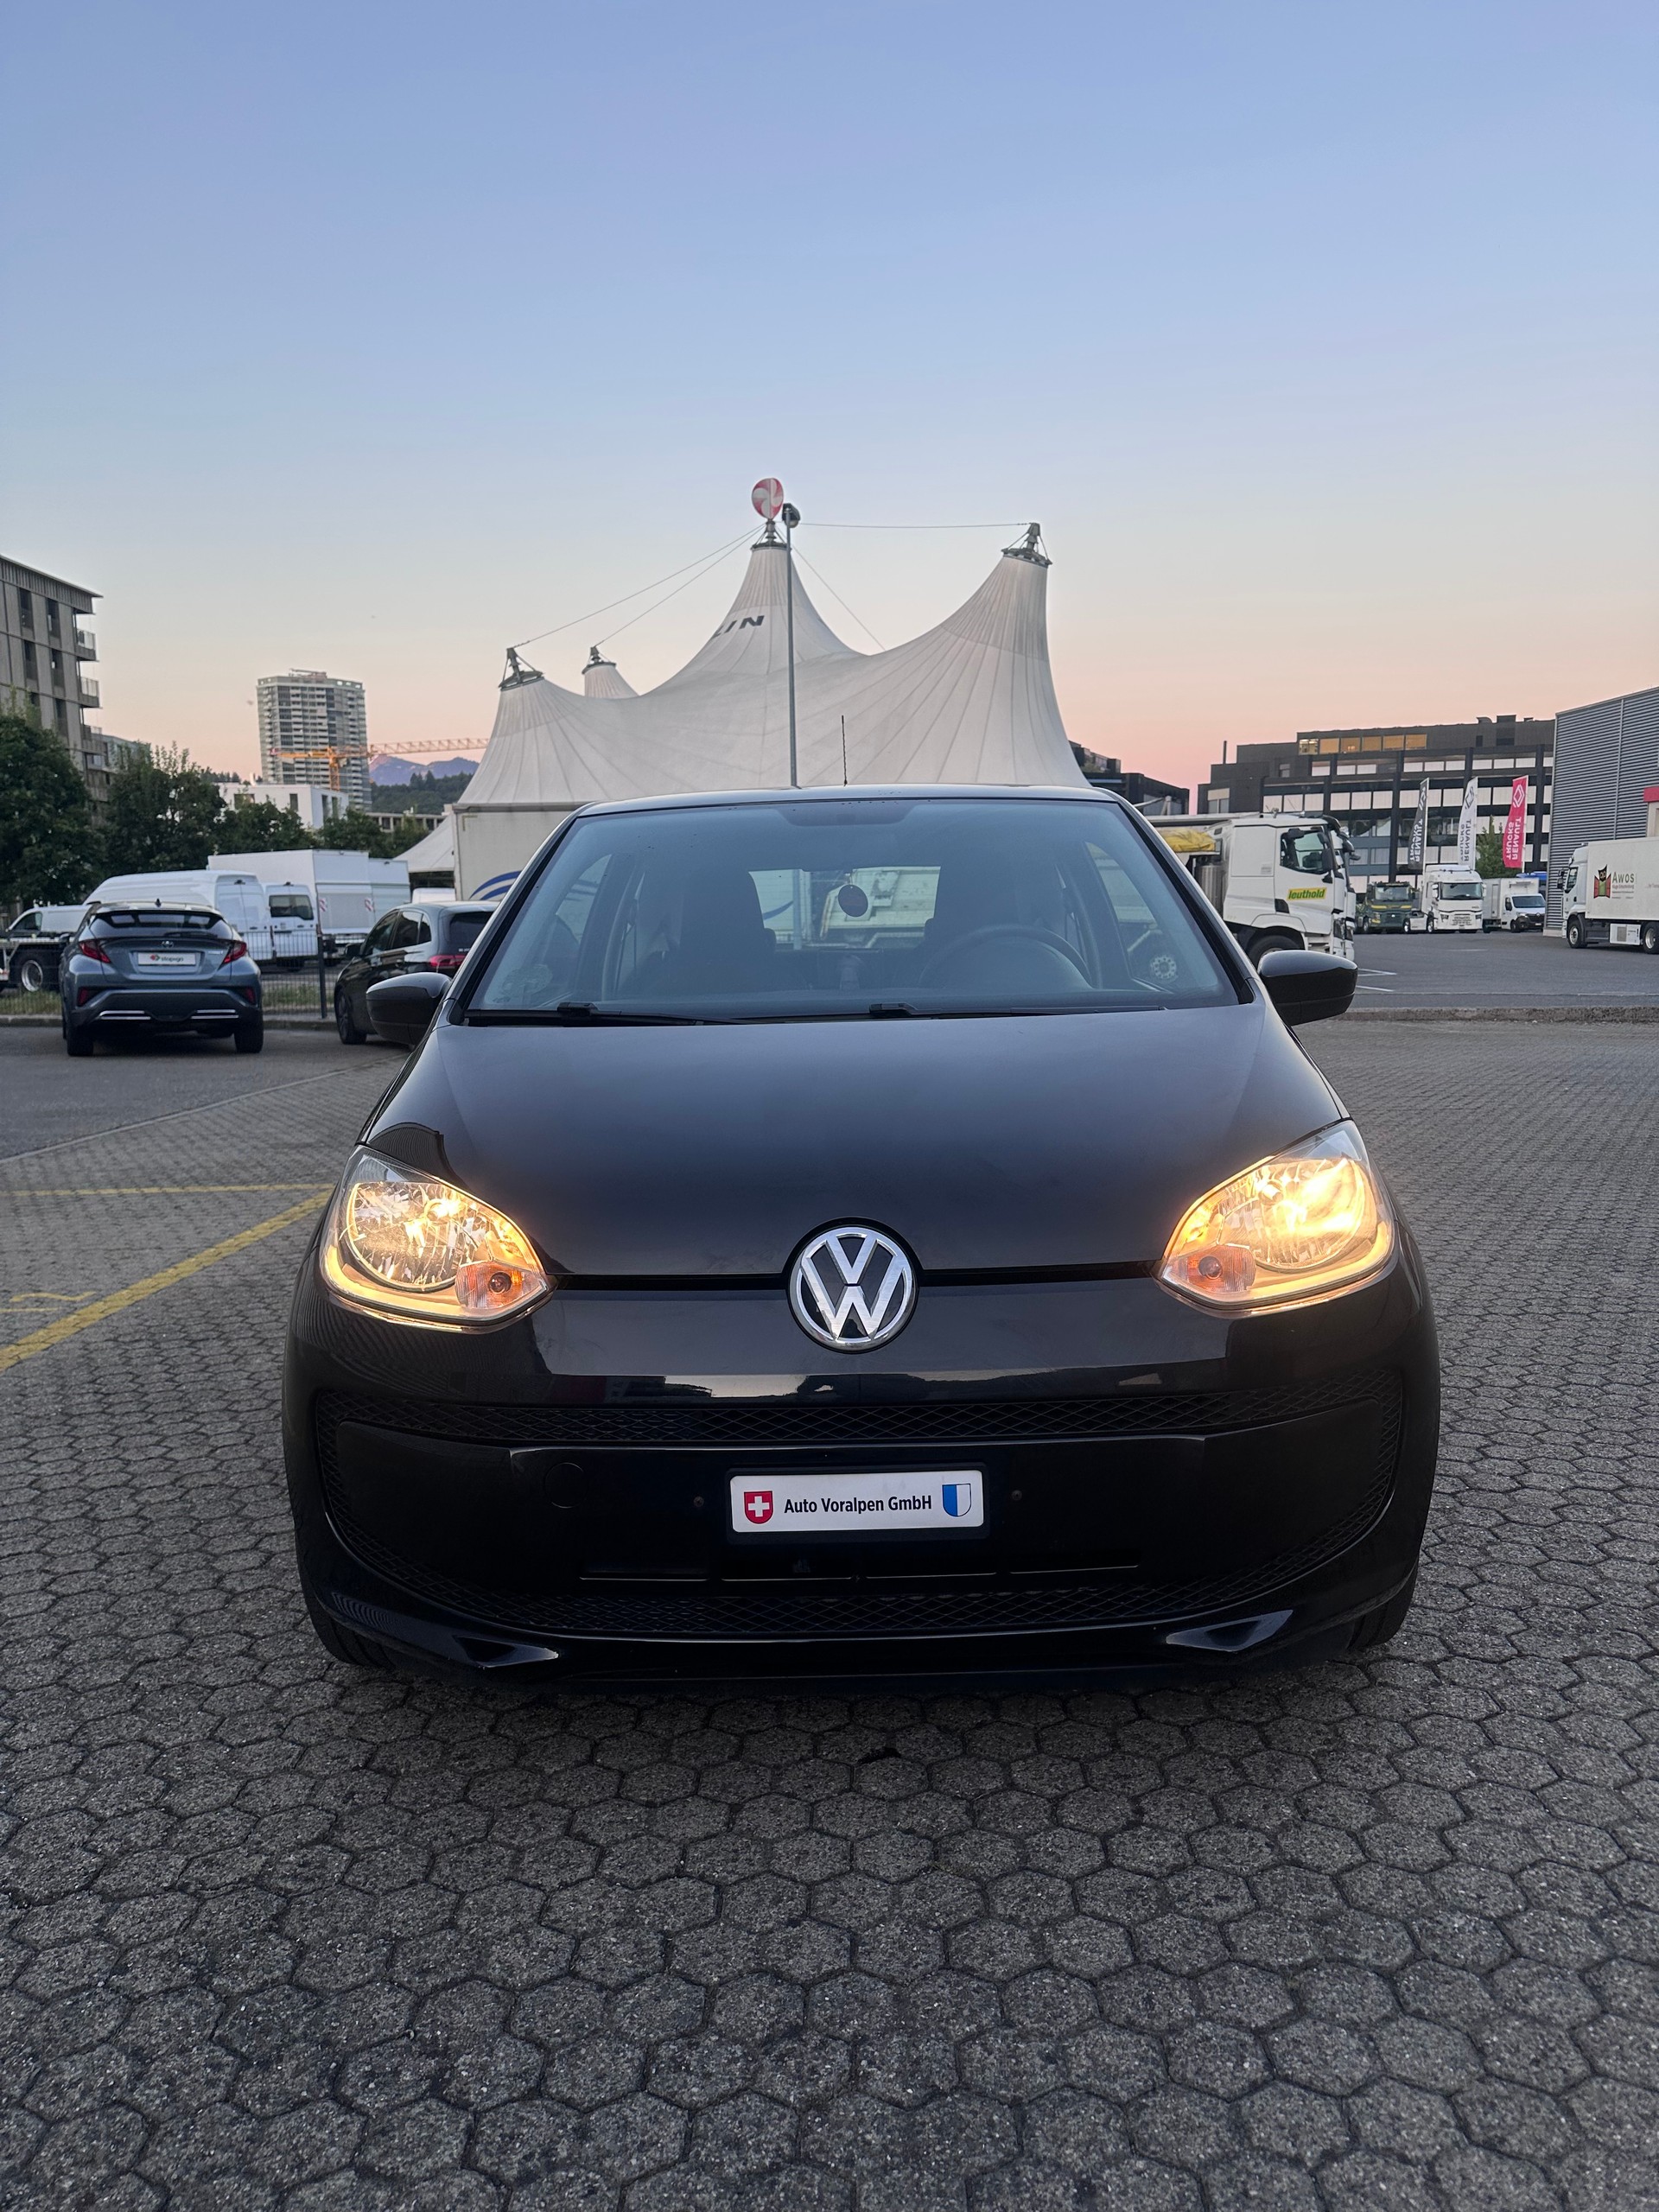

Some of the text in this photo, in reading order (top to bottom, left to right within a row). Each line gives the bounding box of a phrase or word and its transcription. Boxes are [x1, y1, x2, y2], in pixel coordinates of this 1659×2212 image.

[1288, 888, 1325, 899] leuthold
[796, 1227, 912, 1344] VW
[784, 1495, 932, 1516] Auto Voralpen GmbH
